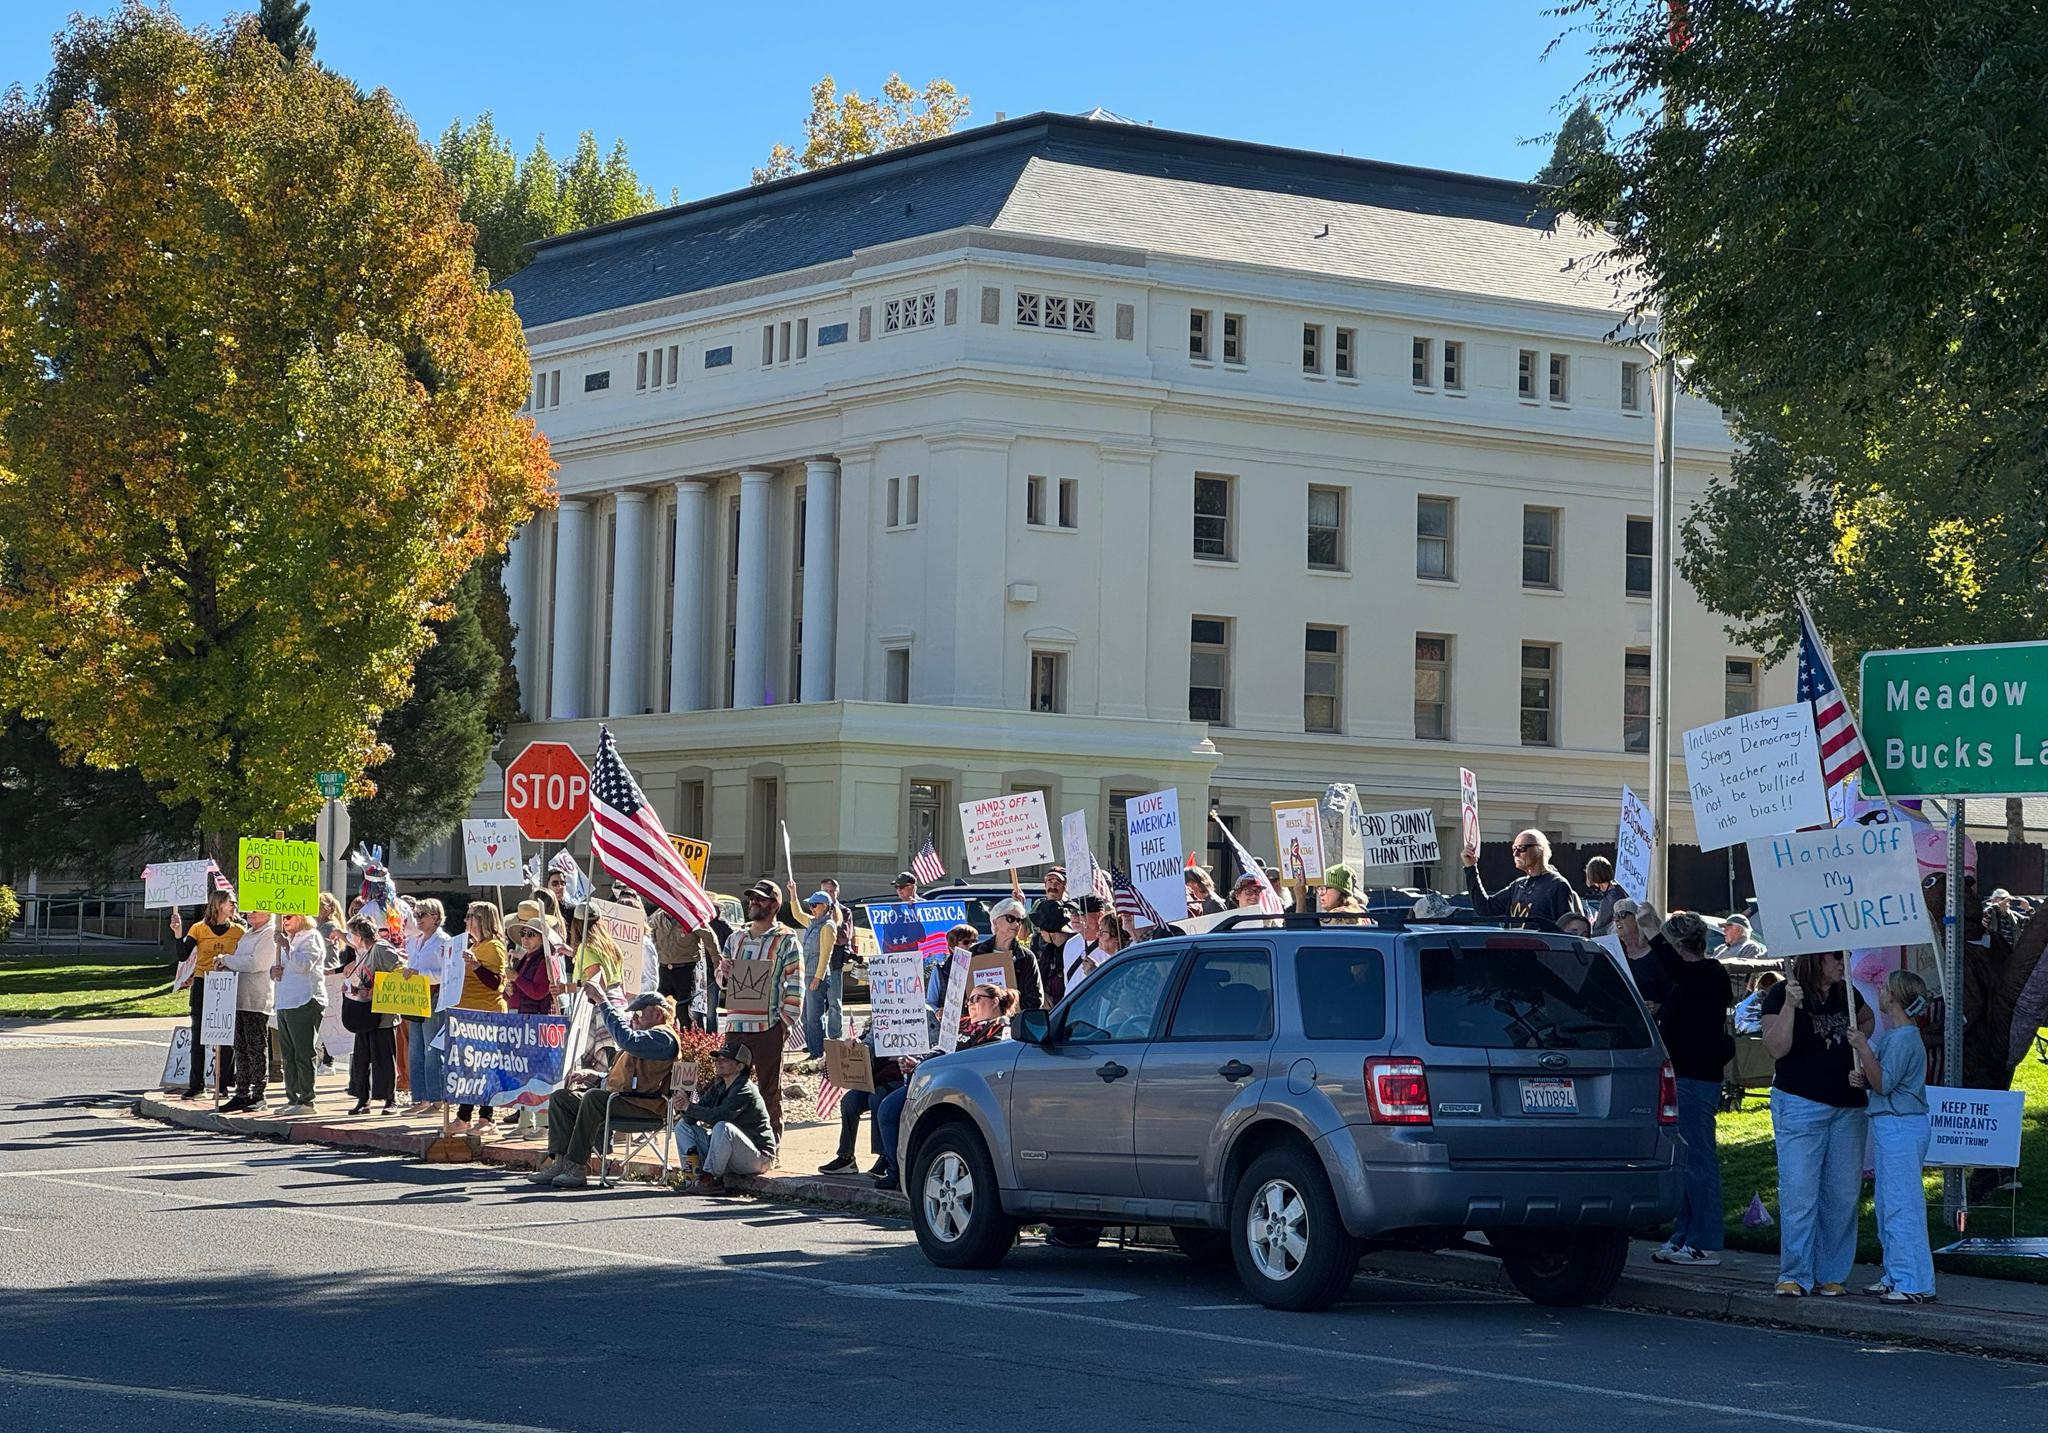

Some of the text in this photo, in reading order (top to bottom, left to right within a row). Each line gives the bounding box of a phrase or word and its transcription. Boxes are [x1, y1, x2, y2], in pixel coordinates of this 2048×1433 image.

[1887, 675, 2027, 711] Meadow
[1688, 726, 1732, 751] Inclusive
[1740, 715, 1780, 734] History
[1740, 725, 1808, 753] Democracy!
[1886, 736, 1993, 769] Bucks
[1692, 752, 1798, 801] This teacher will
[511, 773, 586, 811] STOP
[1705, 769, 1805, 814] not be bullied
[975, 796, 1028, 817] HANDS OFF
[1137, 796, 1163, 815] LOVE
[1717, 795, 1793, 830] into bias!!
[976, 812, 1030, 831] DEMOCRACY
[1130, 811, 1176, 836] AMERICA!
[1359, 810, 1432, 837] BAD BUNNY
[968, 834, 985, 844] DUE
[987, 828, 1014, 840] PROCESS
[1026, 822, 1039, 831] ALL
[1380, 835, 1418, 846] BIGGER
[246, 842, 314, 858] ARGENTINA
[671, 840, 703, 861] TOP
[985, 839, 1013, 849] AMERICAN
[995, 843, 1040, 858] CONSTITUTION
[1141, 836, 1166, 857] HATE
[1368, 841, 1438, 865] THAN TRUMP
[1773, 827, 1901, 868] Hands Off
[246, 855, 308, 873] 20 BILLION
[474, 856, 516, 873] Lovers
[1136, 856, 1182, 883] TYRANNY
[244, 871, 316, 887] US HEALTHCARE
[1823, 870, 1854, 896] My
[256, 899, 306, 913] NOT OKAY!
[872, 905, 966, 925] PRO-AMERICA
[1789, 893, 1919, 941] FUTURE!!
[382, 982, 396, 992] NO
[871, 976, 923, 995] AMERICA
[376, 993, 398, 1004] LOCK
[449, 1016, 566, 1048] Democracy Is NOT
[882, 1032, 917, 1049] CROSS
[174, 1055, 185, 1078] Yes
[448, 1044, 529, 1073] A Spectator
[446, 1071, 487, 1098] Sport
[1525, 1089, 1575, 1108] 5XYD894
[1941, 1100, 1990, 1117] KEEP THE
[1930, 1114, 1999, 1131] IMMIGRANTS
[1936, 1134, 1990, 1147] DEPORT TRUMP
